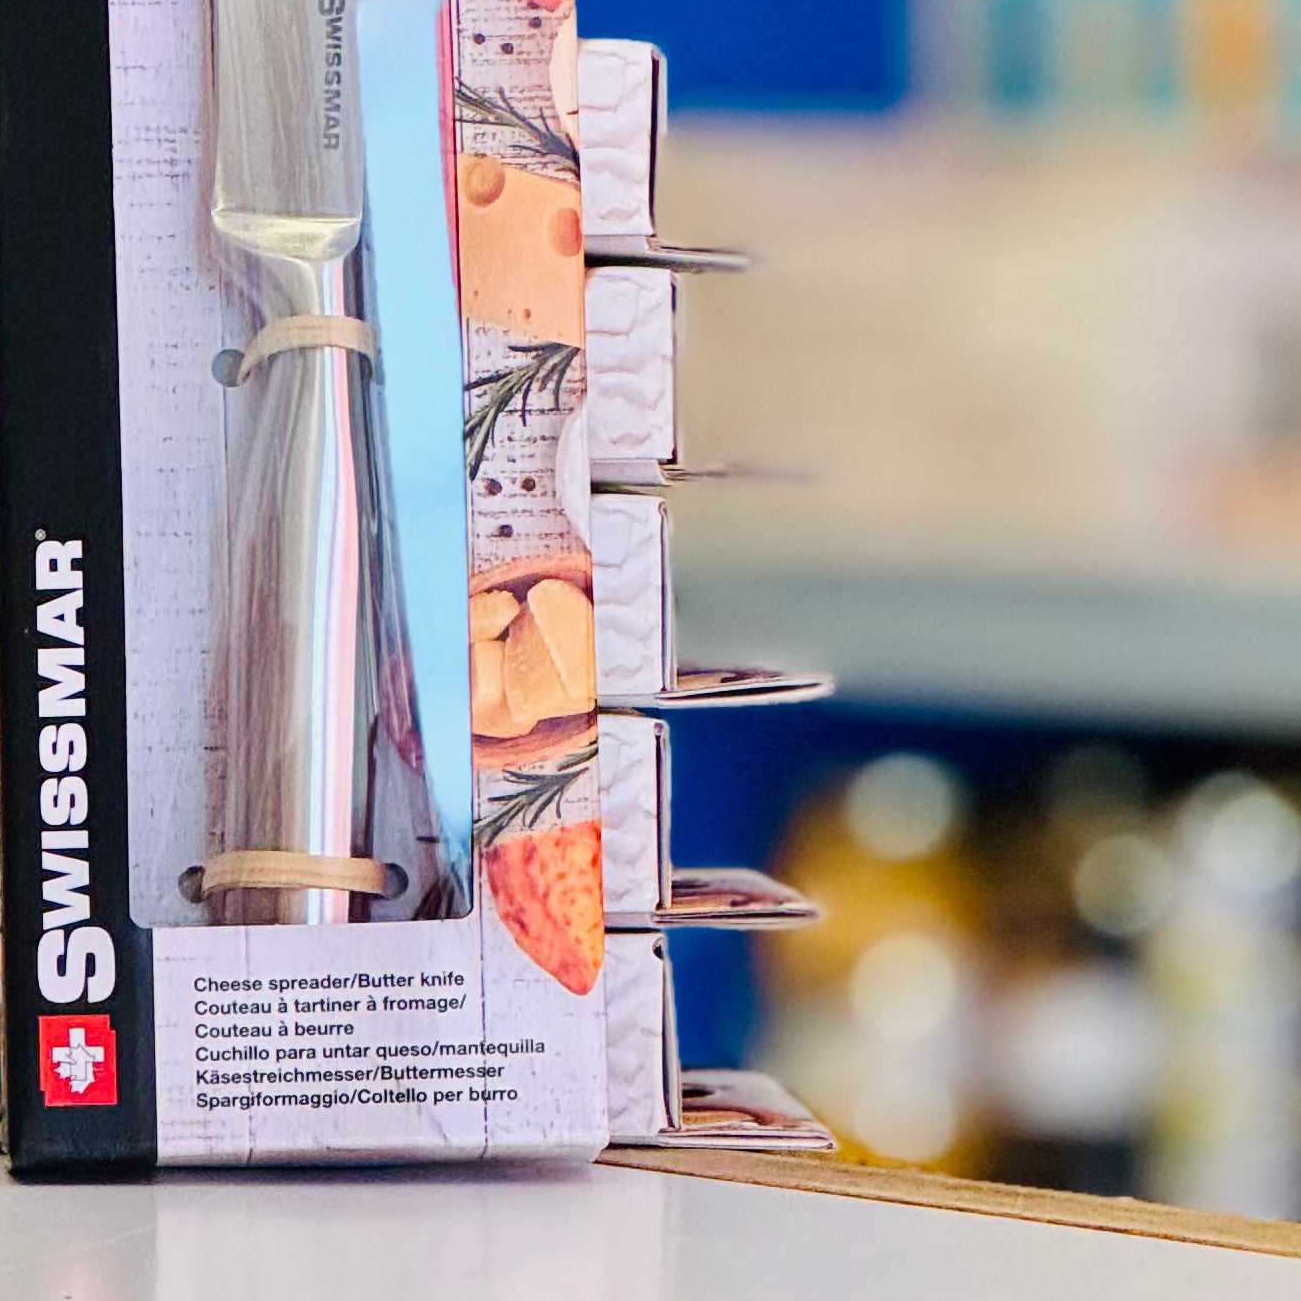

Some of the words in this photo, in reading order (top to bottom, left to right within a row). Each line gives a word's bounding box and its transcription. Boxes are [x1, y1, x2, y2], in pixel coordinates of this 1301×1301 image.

[194, 976, 262, 992] Cheese
[268, 974, 416, 993] spreader/Butter
[420, 971, 464, 987] knife
[194, 1000, 272, 1016] Couteau
[278, 998, 288, 1014] à
[294, 998, 361, 1013] tartiner
[367, 995, 377, 1012] à
[383, 995, 466, 1013] fromage/
[195, 1023, 272, 1039] Couteau
[278, 1021, 288, 1037] à
[295, 1021, 354, 1036] beurre
[195, 1046, 270, 1062] Cuchillo
[276, 1048, 317, 1063] para
[323, 1044, 370, 1059] untar
[375, 1039, 545, 1060] queso/mantequilla
[197, 1064, 505, 1085] Käsestreichmesser/Buttermesser
[197, 1089, 427, 1110] Spargiformaggio/Coltello
[434, 1089, 463, 1105] per
[469, 1087, 517, 1102] burro
